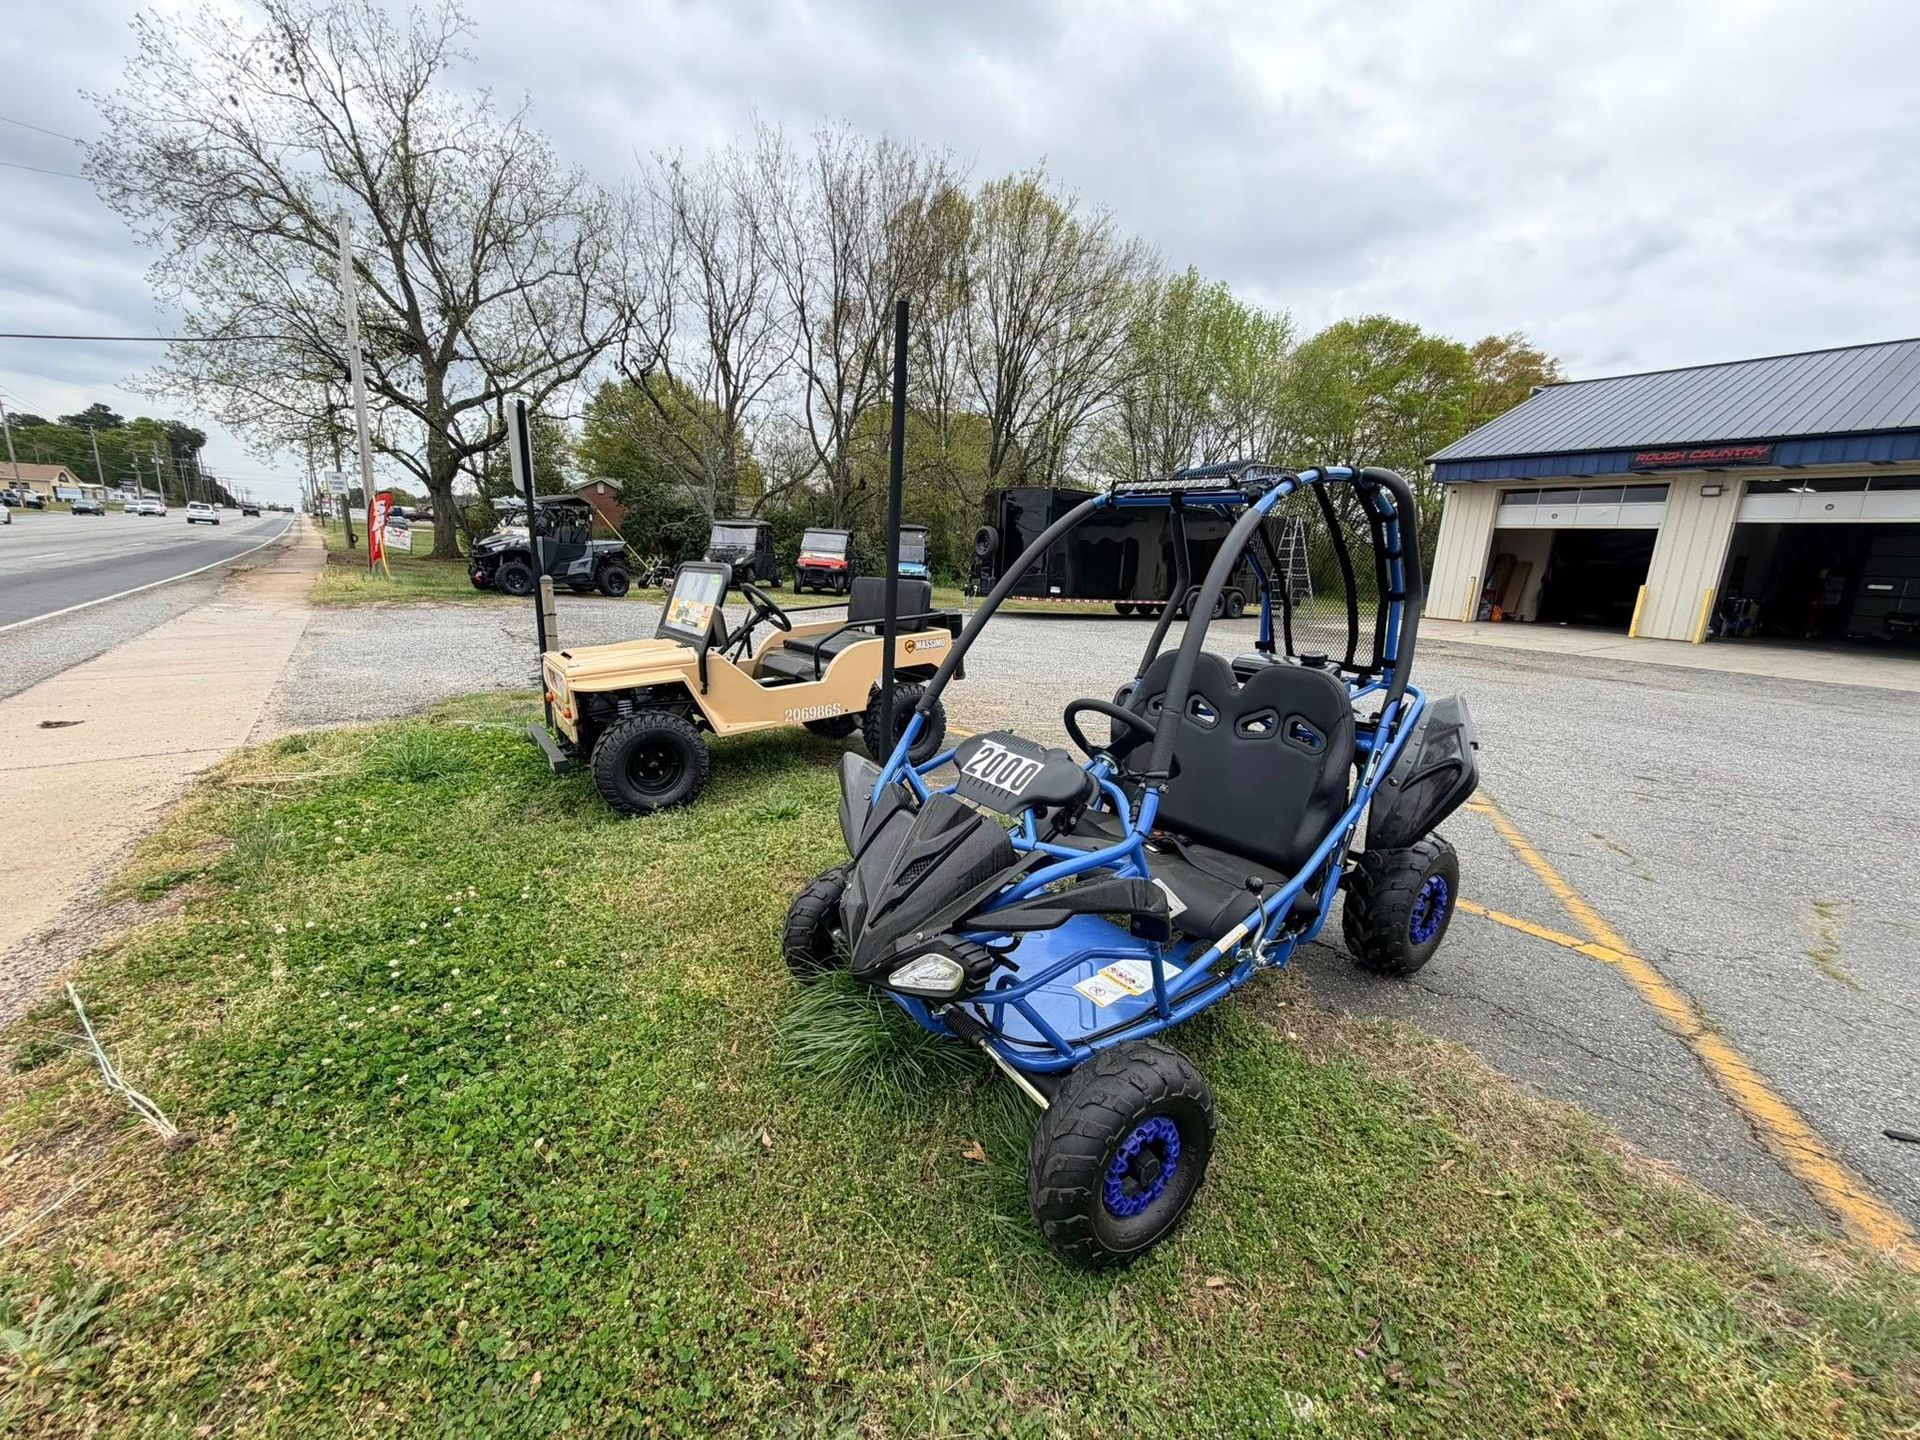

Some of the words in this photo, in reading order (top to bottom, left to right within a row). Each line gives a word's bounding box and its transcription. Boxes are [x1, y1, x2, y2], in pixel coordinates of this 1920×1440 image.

[1635, 451, 1686, 462] ROUGH
[1690, 446, 1767, 459] COUNTRY
[915, 638, 946, 650] MASSIMO
[784, 702, 841, 722] 206986S
[964, 747, 1039, 791] 2000
